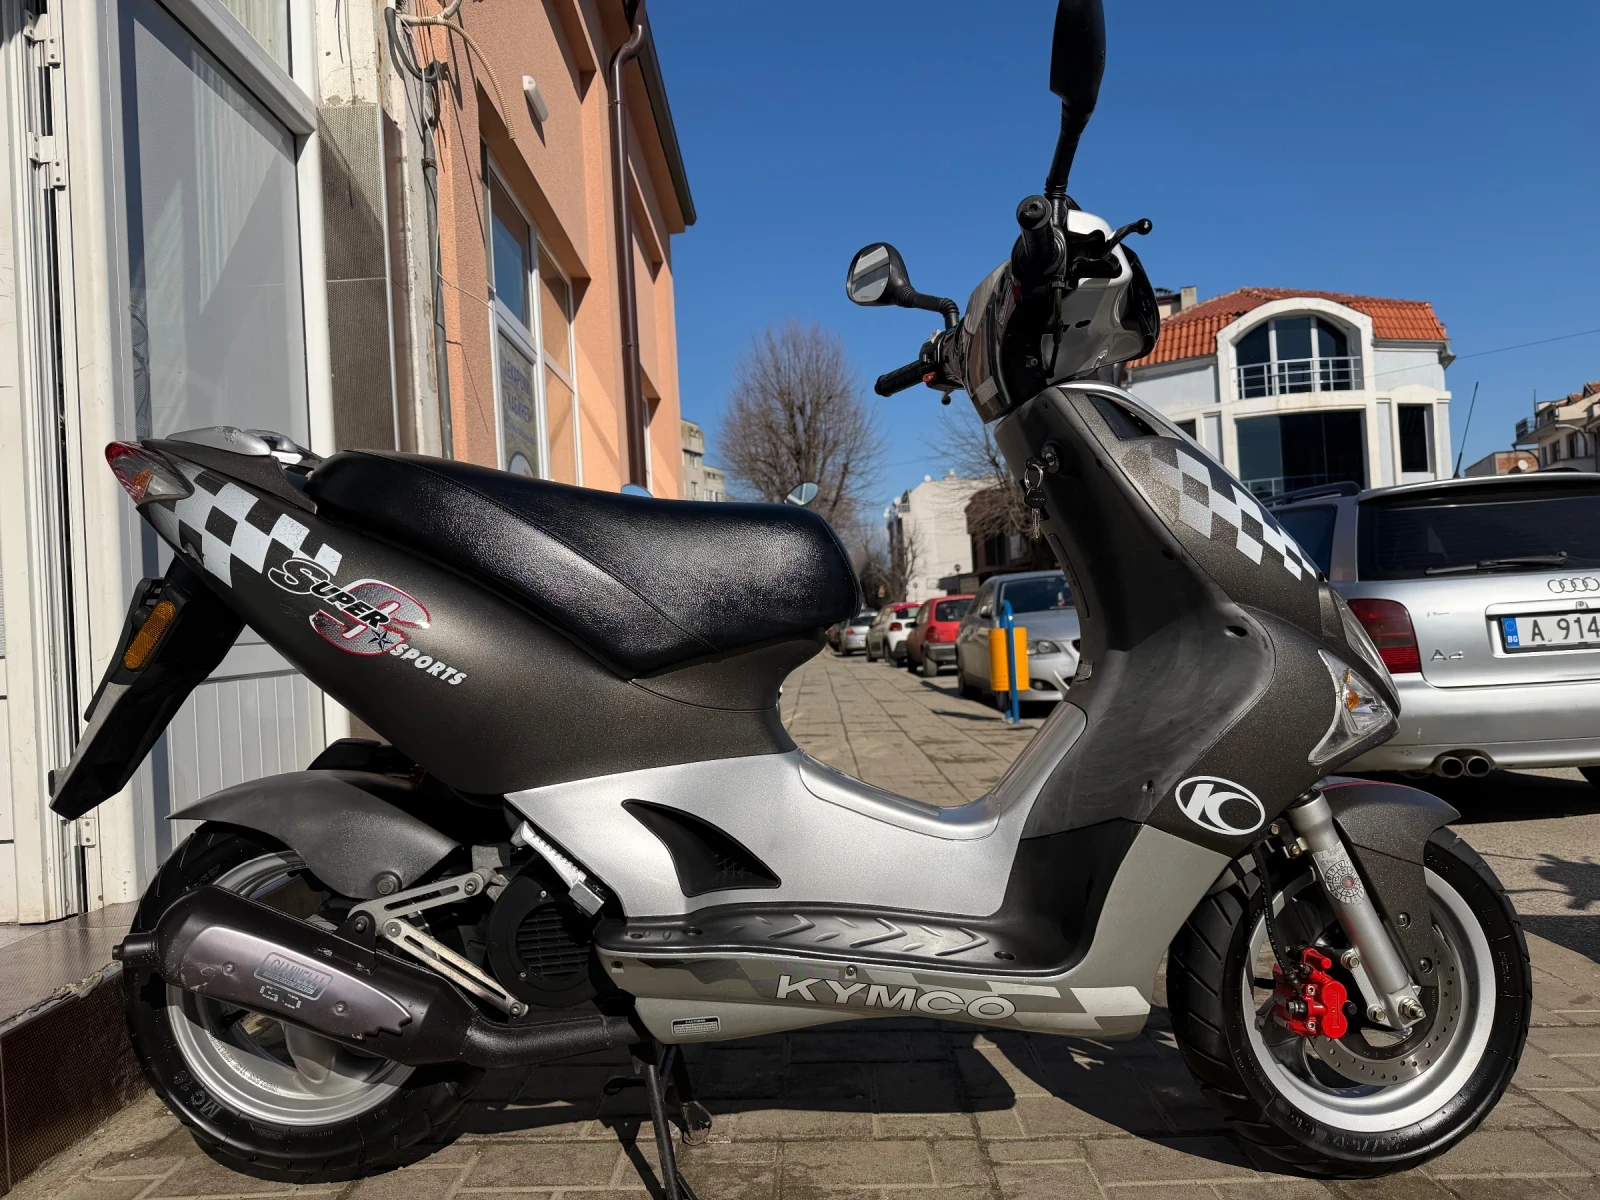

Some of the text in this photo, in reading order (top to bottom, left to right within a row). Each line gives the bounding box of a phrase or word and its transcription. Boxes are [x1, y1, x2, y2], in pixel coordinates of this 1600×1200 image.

[268, 559, 390, 629] SUPER
[1430, 649, 1464, 661] A4
[1507, 635, 1519, 643] BG
[390, 643, 467, 685] SPORTS
[776, 975, 1016, 1020] KYMCO
